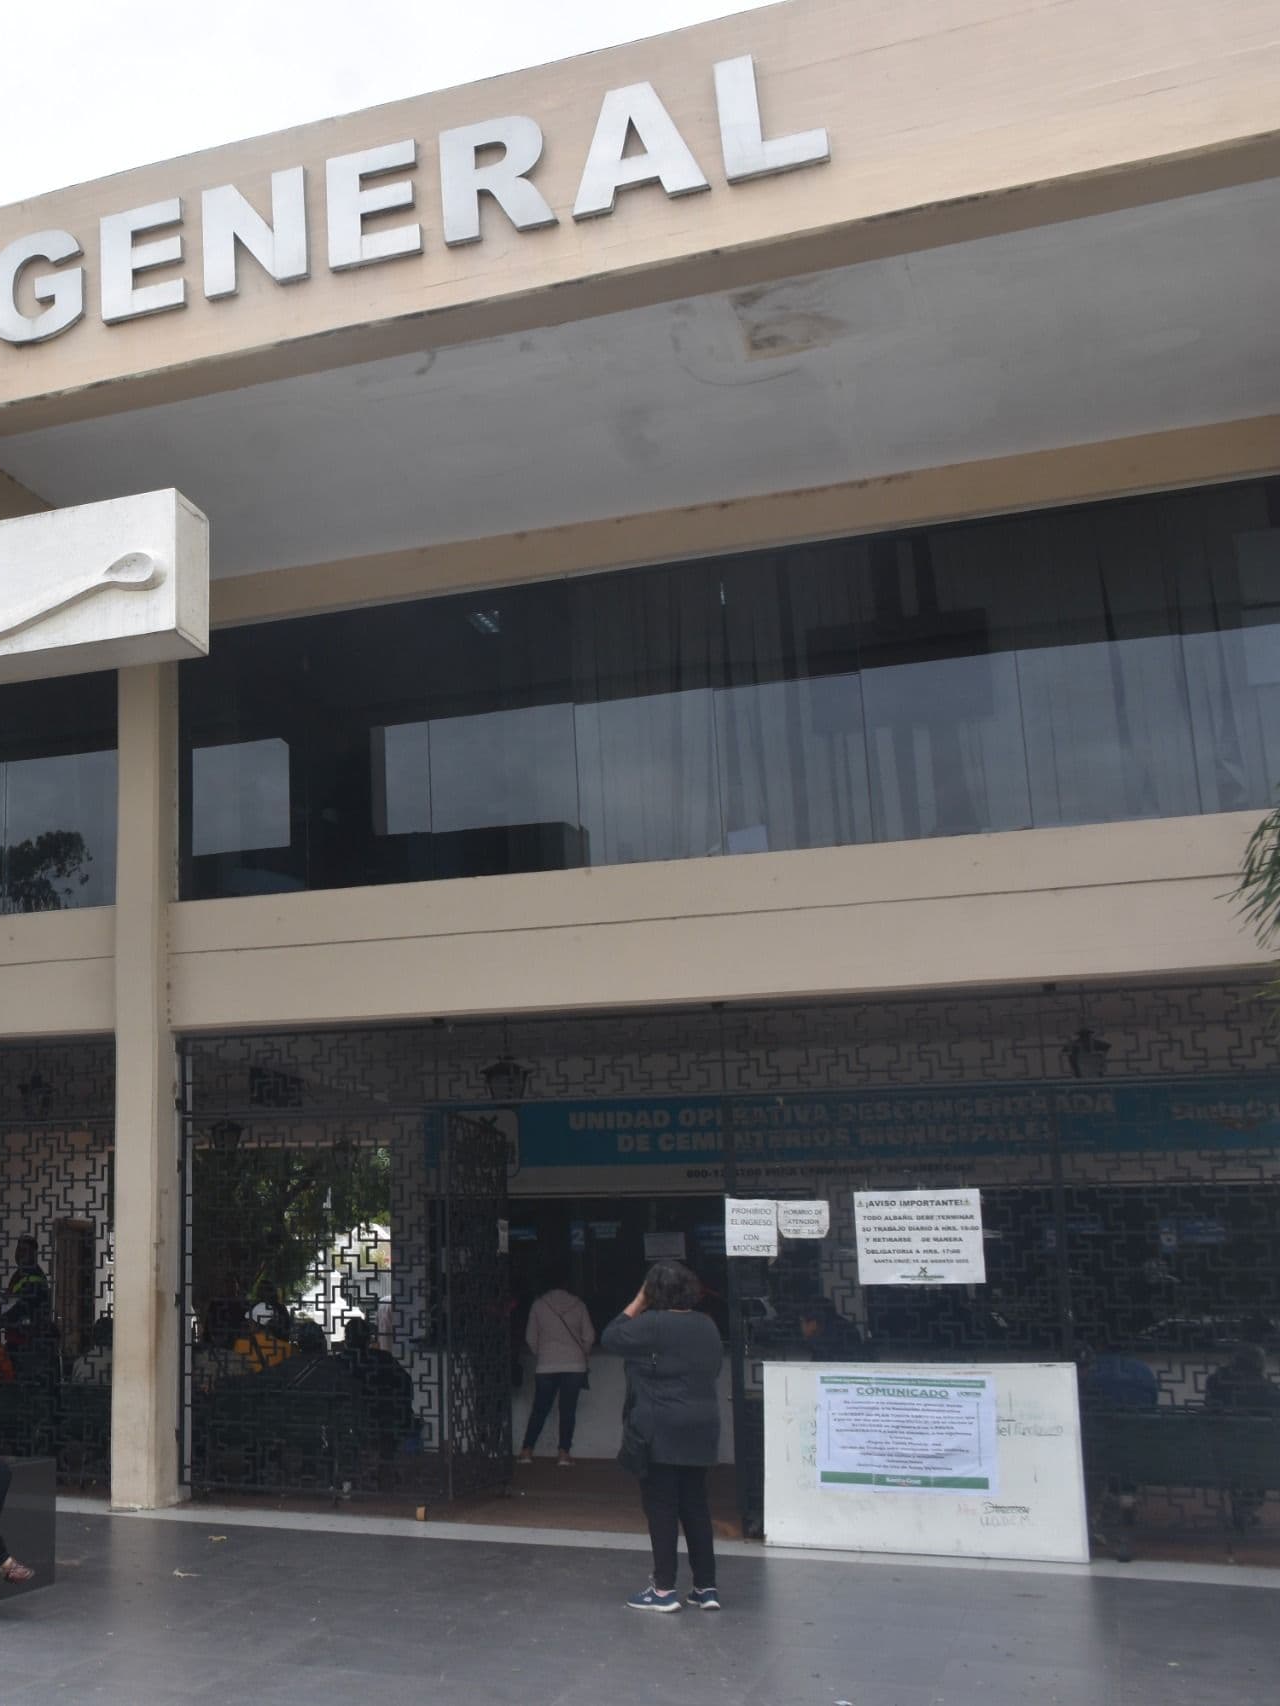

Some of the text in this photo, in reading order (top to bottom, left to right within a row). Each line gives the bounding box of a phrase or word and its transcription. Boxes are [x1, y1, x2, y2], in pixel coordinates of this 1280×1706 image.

[568, 1109, 671, 1130] UNIDAD
[617, 1134, 650, 1152] DE
[865, 1199, 963, 1208] ¡AVISO IMPORTANTE!
[731, 1207, 772, 1215] PROHIBIDO
[783, 1208, 822, 1216] HORARIO DE
[730, 1218, 772, 1226] EL INGRESO
[571, 1229, 585, 1245] 2
[1046, 1229, 1057, 1247] 5
[1160, 1227, 1177, 1246] 6
[856, 1386, 949, 1399] COMUNICADO
